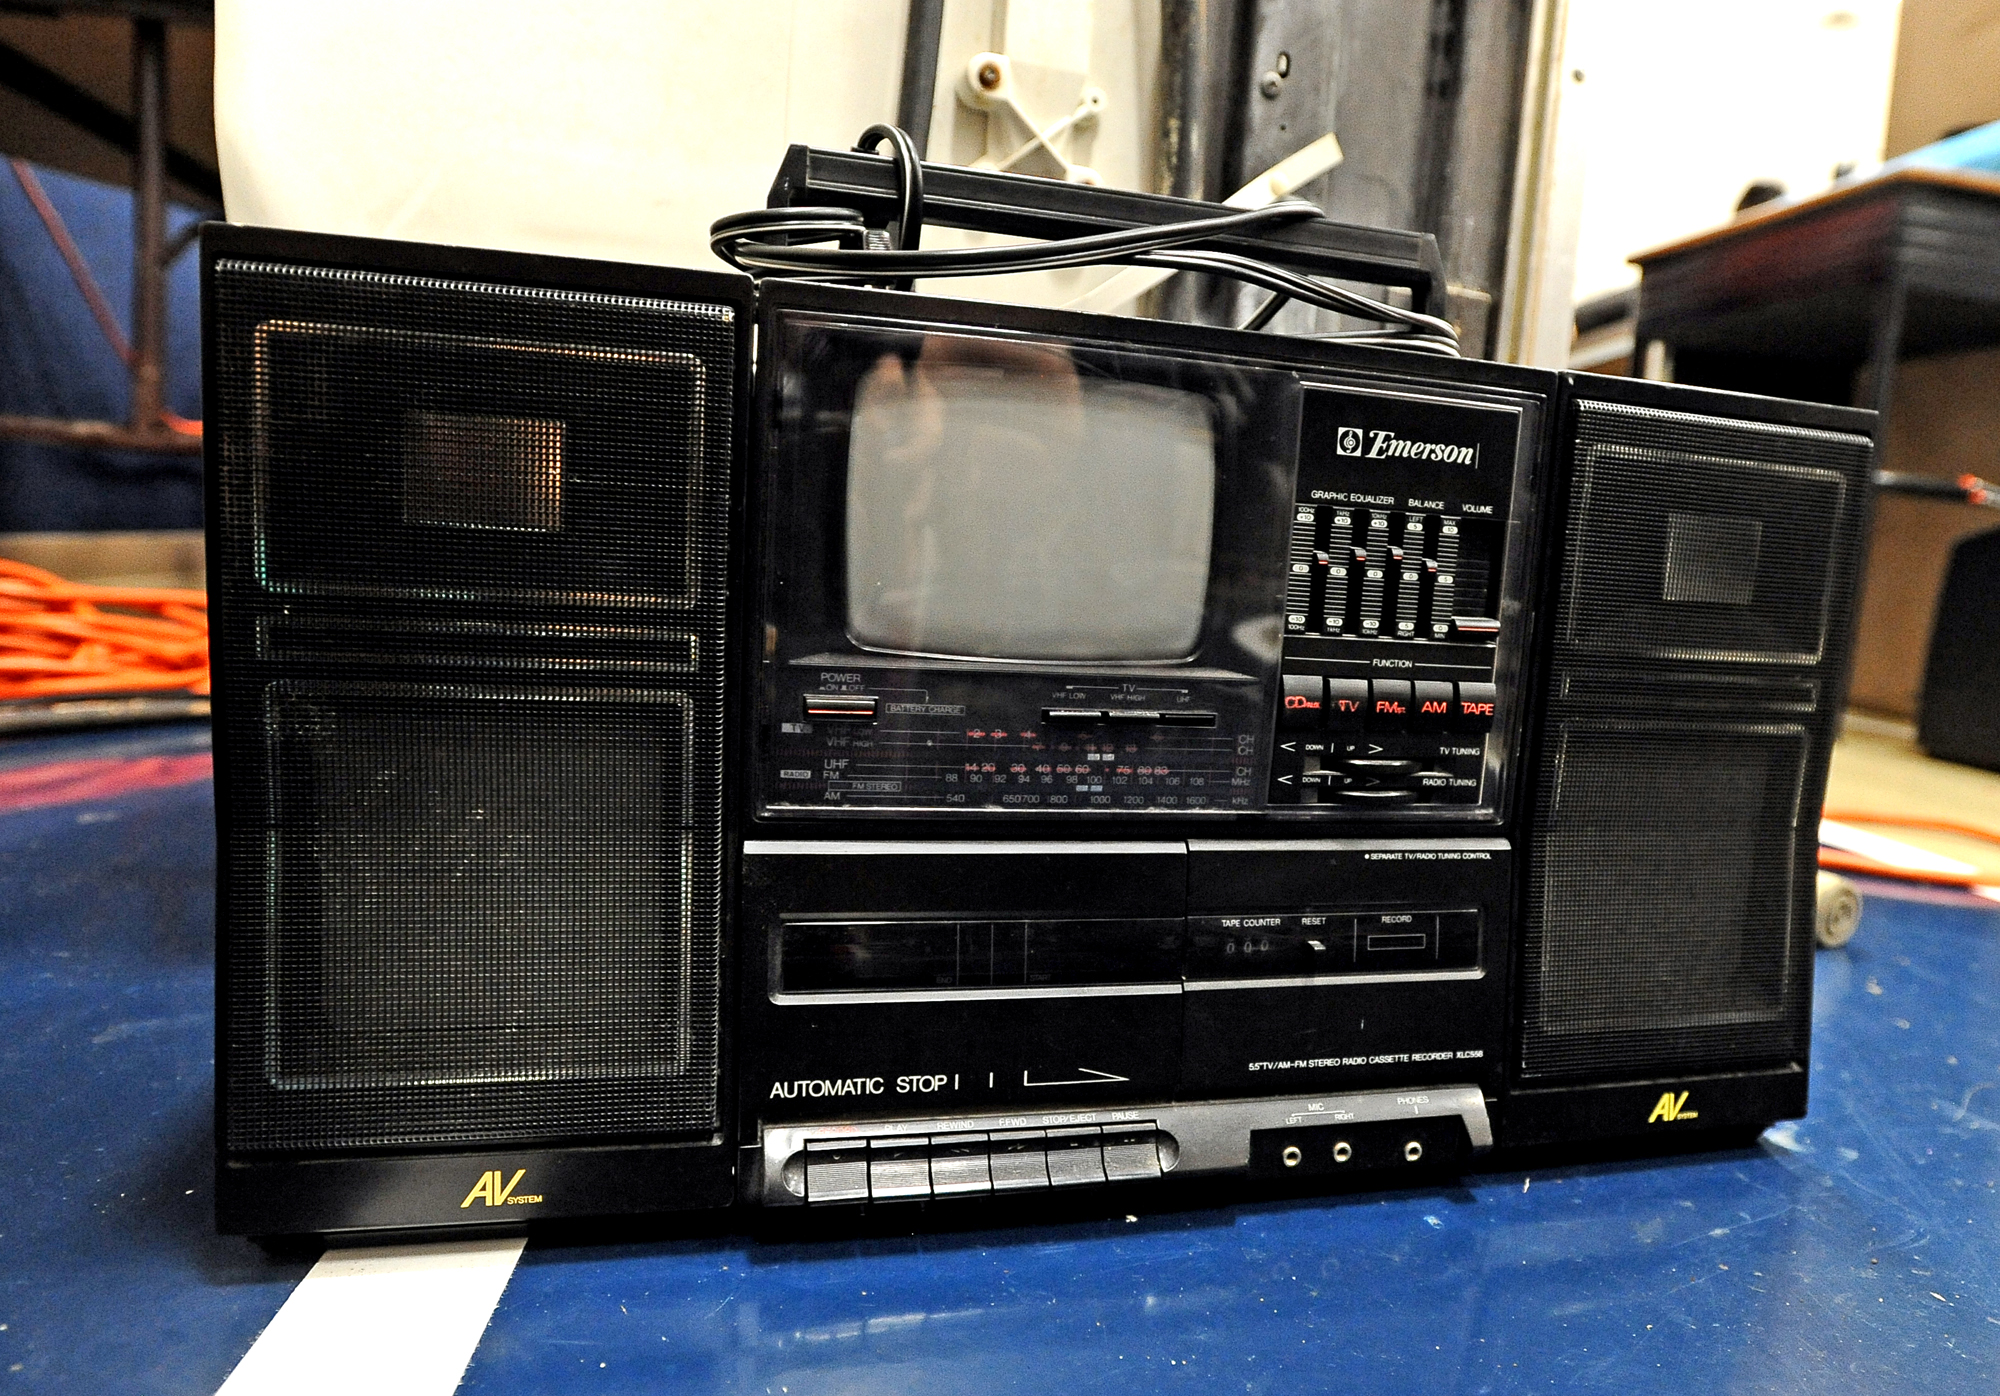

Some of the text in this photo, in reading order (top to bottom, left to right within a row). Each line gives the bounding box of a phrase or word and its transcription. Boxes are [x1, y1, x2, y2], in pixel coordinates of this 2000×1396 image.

[1365, 430, 1474, 465] Emerson
[1311, 490, 1395, 505] GRAPHIC EQUALIZER
[1408, 498, 1445, 510] BALANCE
[1462, 503, 1494, 514] VOLUME
[1372, 658, 1413, 669] FUNCTION
[820, 672, 861, 683] POWER
[849, 684, 866, 692] OFF
[1122, 684, 1136, 692] TV
[1068, 692, 1087, 700] LOW
[890, 704, 962, 714] BATTERY CHARGE
[1338, 699, 1360, 712] TV
[1421, 701, 1447, 714] AM
[1461, 702, 1495, 716] TAPE
[1239, 734, 1254, 744] CH
[825, 736, 850, 747] VHF
[852, 740, 874, 748] HIGH
[1237, 745, 1254, 756] CH
[1305, 743, 1324, 751] DOWN
[1440, 747, 1480, 757] TV TUNING
[823, 758, 850, 770] UHF
[1236, 766, 1252, 776] CH
[823, 770, 1251, 786] FM 88 90 92 94 96 98 100 102 104 106 108 MHz
[1302, 776, 1321, 784] DOWN
[1423, 778, 1477, 787] RADIO TUNING
[852, 782, 898, 791] FM STEREO
[823, 791, 1249, 805] AM 540 650 700 800 1000 1200 1400 1600 kHz
[1371, 852, 1492, 860] SEPARATE TV/RADIO TUNING CONTROL
[1221, 918, 1281, 928] TAPE COUNTER
[1301, 917, 1326, 925] RESET
[1381, 915, 1412, 923] RECORD
[1308, 1058, 1341, 1068] STEREO
[1342, 1056, 1367, 1065] RADIO
[1368, 1054, 1410, 1064] CASSETTE
[1411, 1051, 1453, 1061] RECORDER
[769, 1075, 948, 1099] AUTOMATIC STOP
[1397, 1095, 1430, 1105] PHONES
[1307, 1102, 1325, 1112] MIC
[1647, 1090, 1690, 1124] AV
[1042, 1112, 1097, 1125] STOP/EJECT
[1111, 1111, 1140, 1121] PAUSE
[1286, 1116, 1303, 1125] LEFT
[1334, 1112, 1355, 1121] RIGHT
[884, 1124, 908, 1133] PLAY
[936, 1120, 975, 1131] REWIND
[460, 1168, 543, 1209] AV SYSTEM
